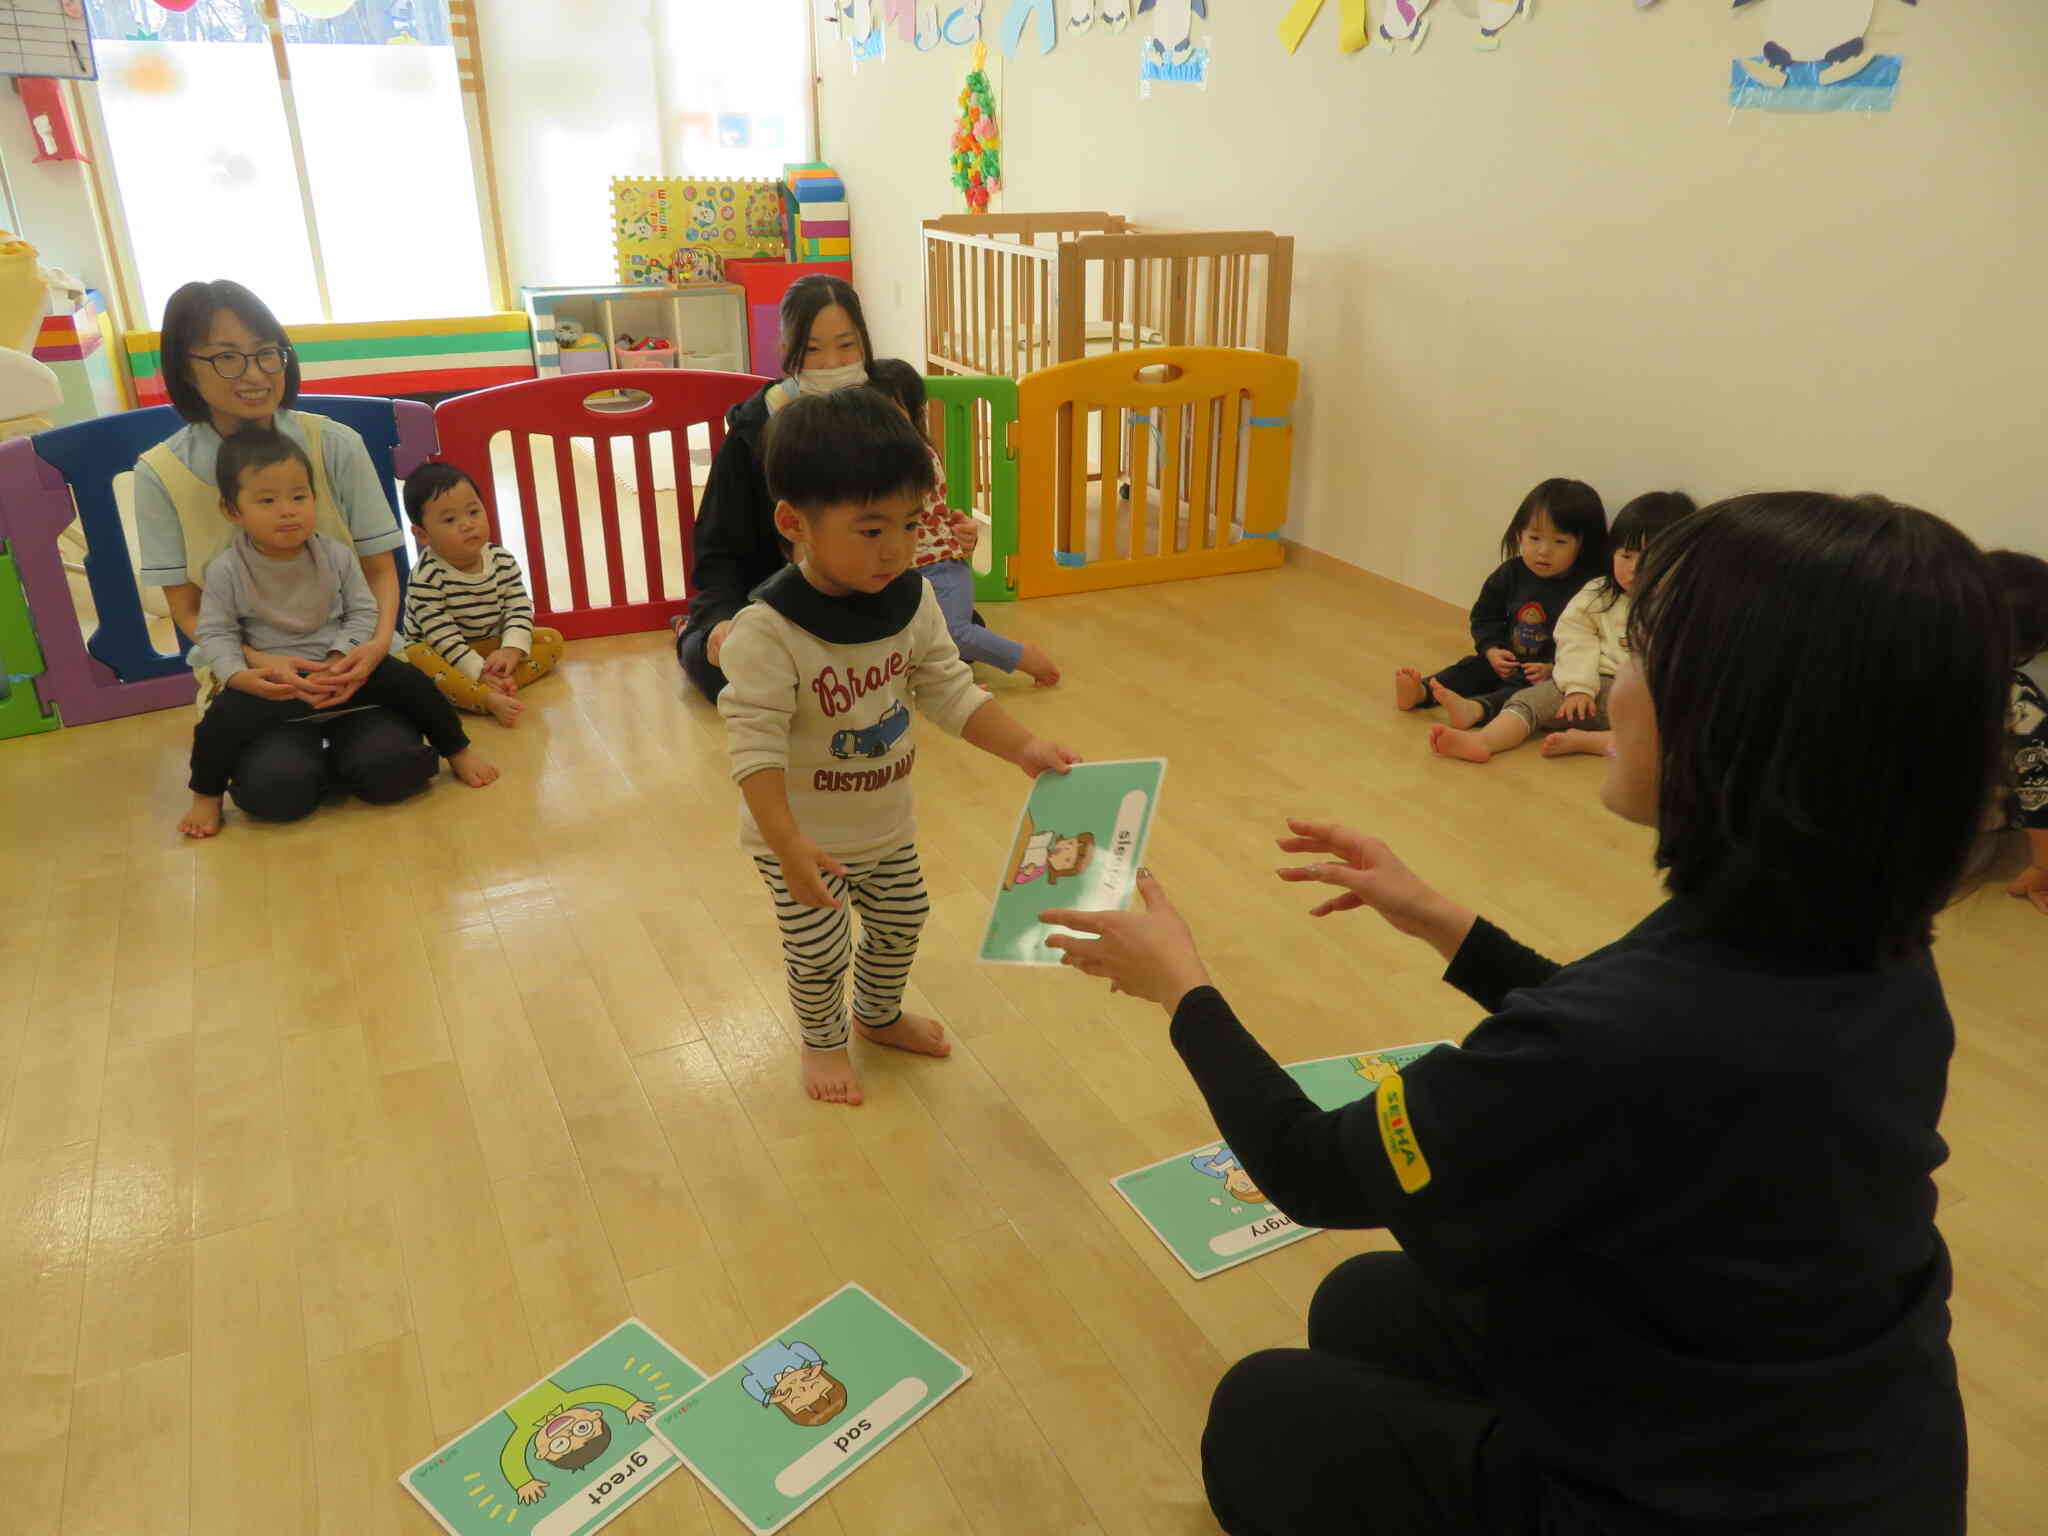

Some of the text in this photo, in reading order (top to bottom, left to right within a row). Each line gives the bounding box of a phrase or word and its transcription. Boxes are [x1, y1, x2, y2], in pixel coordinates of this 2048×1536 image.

[1249, 1215, 1296, 1239] ngry
[832, 1417, 873, 1454] sad
[587, 1453, 649, 1507] great
